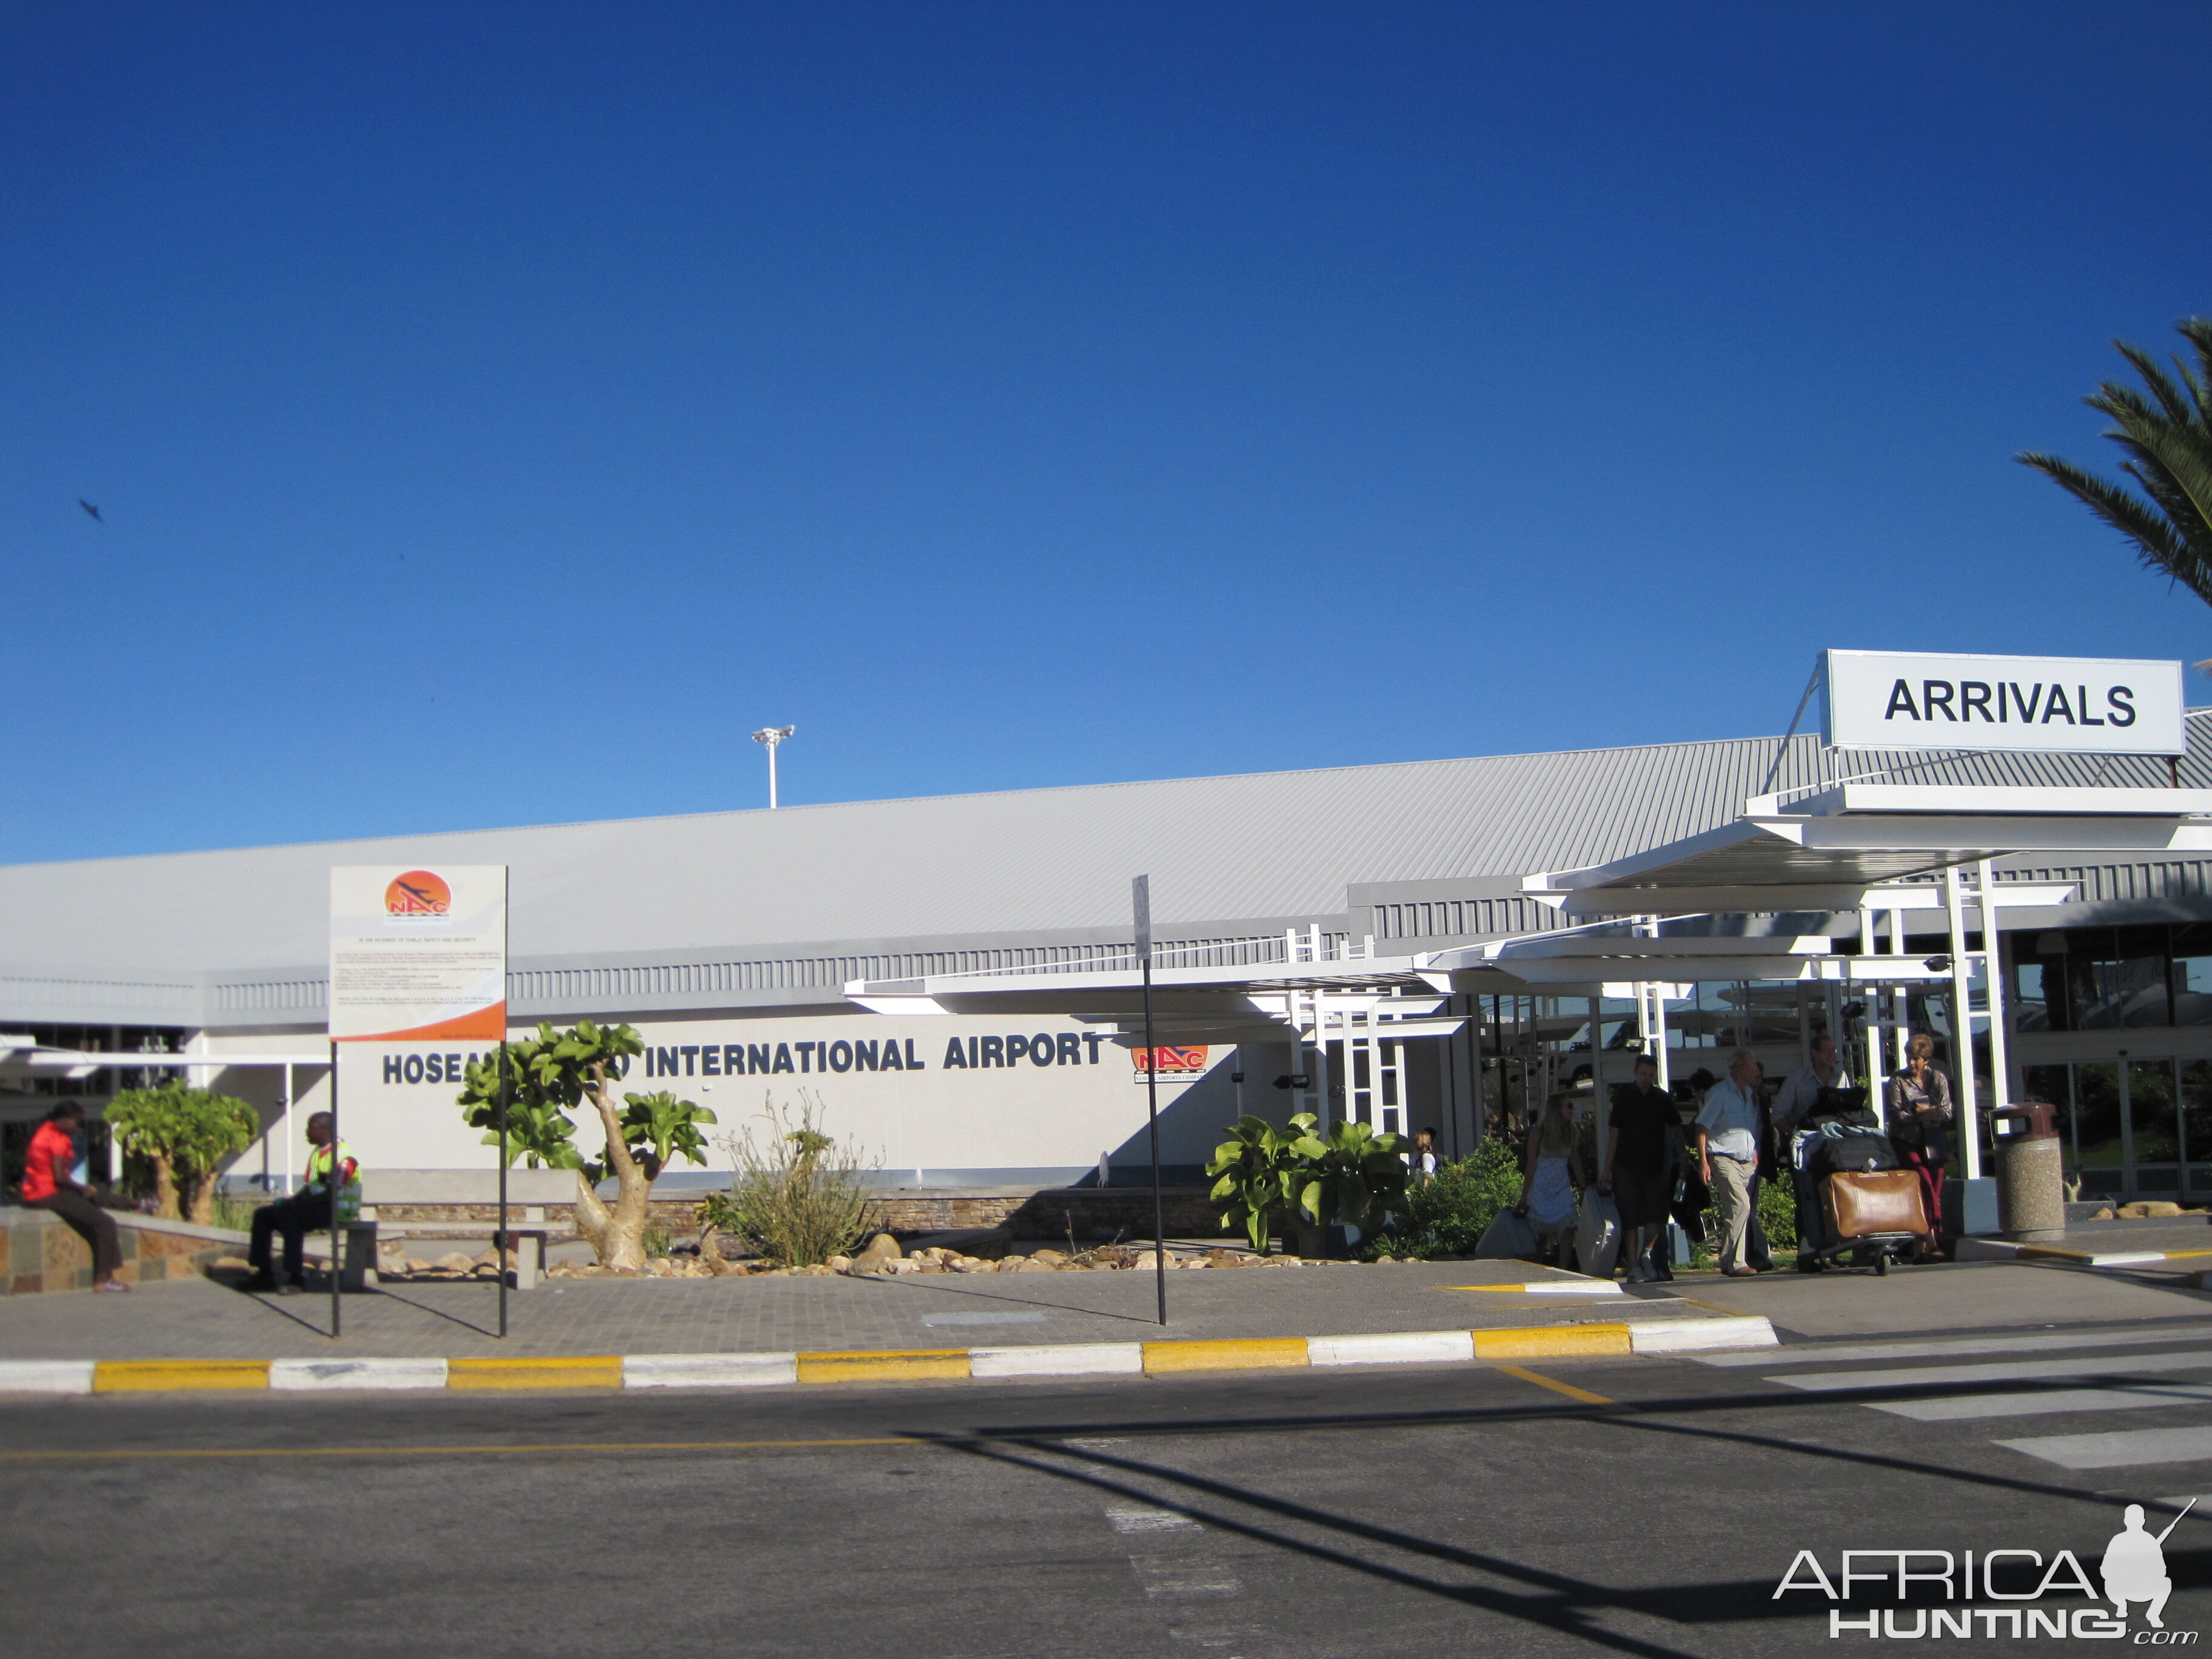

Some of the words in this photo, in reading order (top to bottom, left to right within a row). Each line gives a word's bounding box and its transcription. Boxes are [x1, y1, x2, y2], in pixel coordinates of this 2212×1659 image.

[1884, 679, 2136, 728] ARRIVALS
[389, 887, 447, 913] NAC
[645, 1038, 925, 1078] INTERNATIONAL
[942, 1031, 1107, 1069] AIRPORT
[1139, 1047, 1204, 1069] NAC
